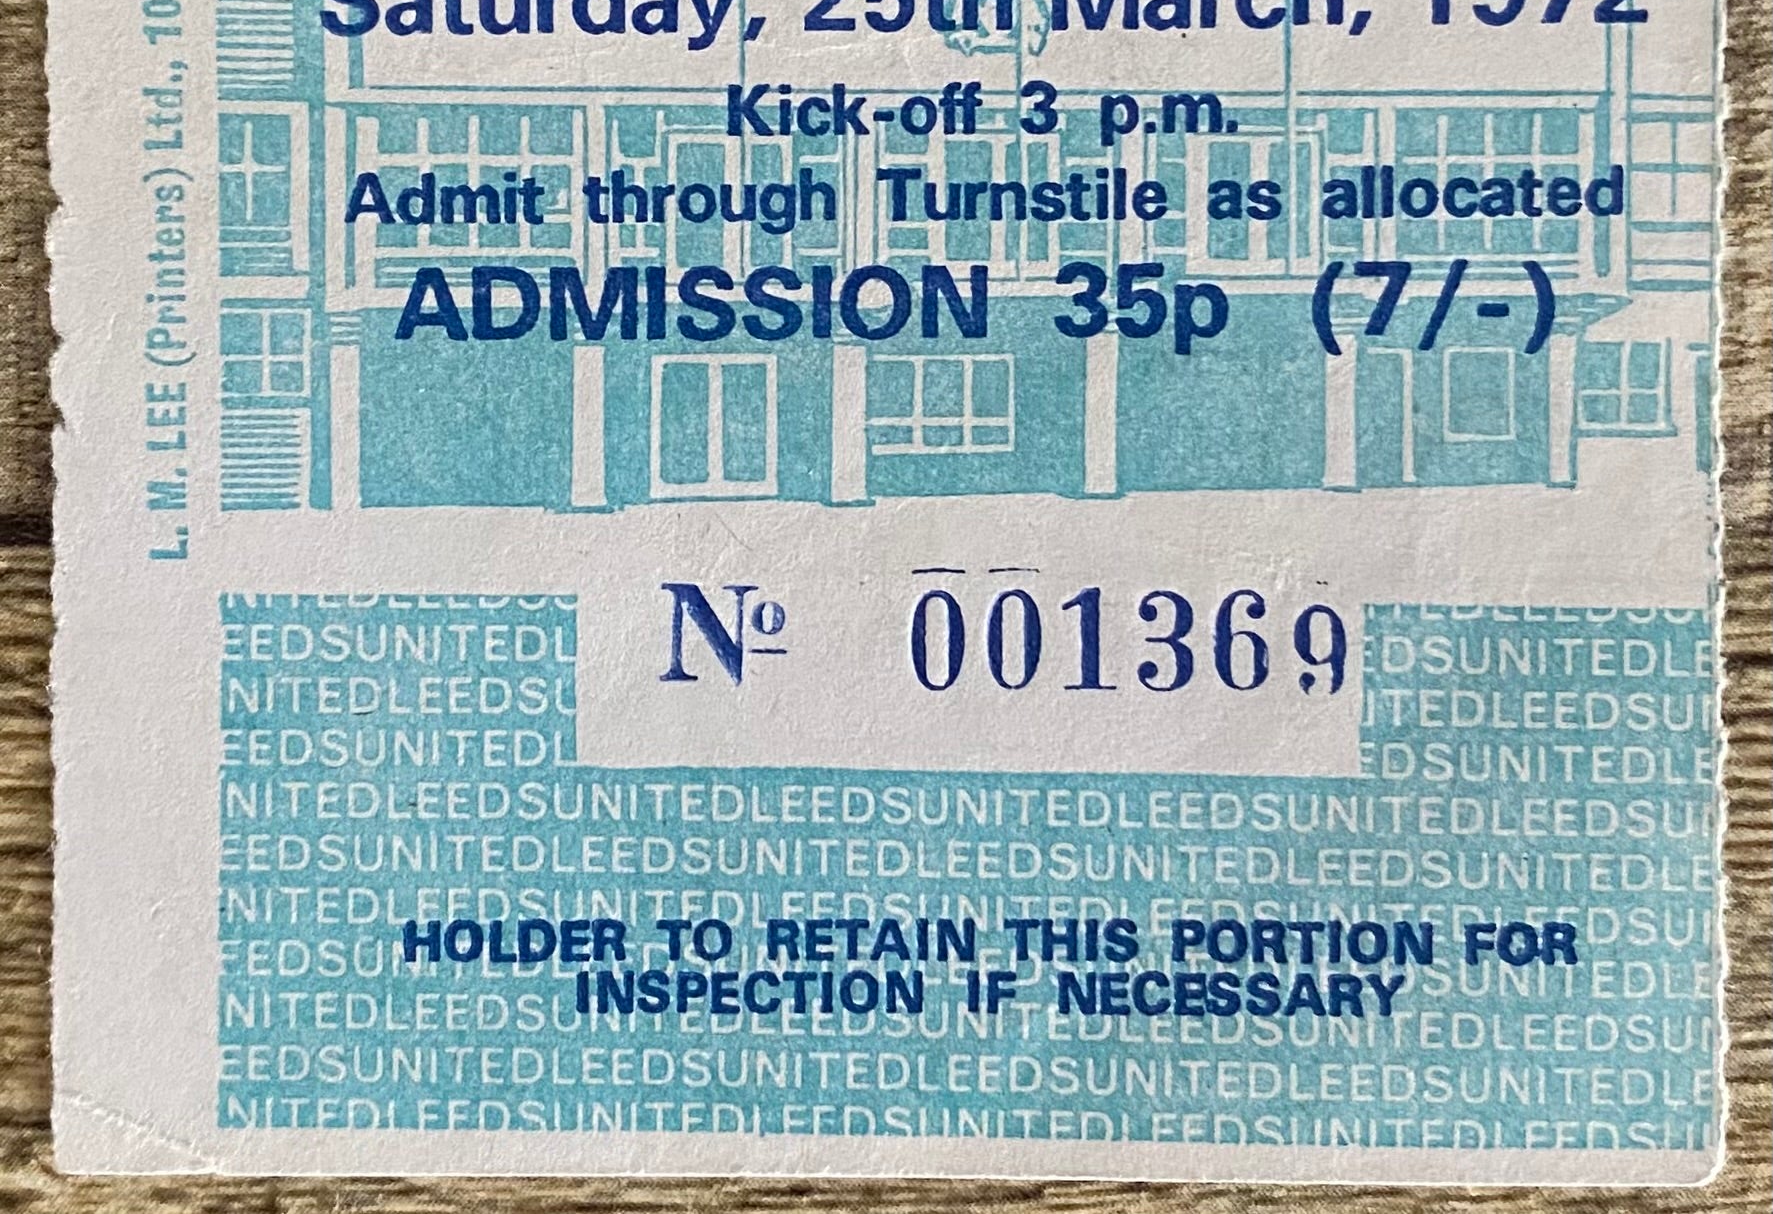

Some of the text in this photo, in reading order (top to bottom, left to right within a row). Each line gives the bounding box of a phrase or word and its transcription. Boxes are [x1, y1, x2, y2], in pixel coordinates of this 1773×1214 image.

[143, 60, 188, 151] Ltd.,
[726, 80, 1239, 146] Kick-off 3 p.m.
[345, 165, 1625, 235] Admit through Turnstile as allocated
[143, 168, 197, 367] (Printers)
[395, 258, 1556, 356] ADMISSION 35p (7/-)
[145, 383, 187, 452] LEE
[146, 468, 188, 511] M.
[147, 526, 189, 561] L.
[911, 587, 1346, 695] 001369
[402, 918, 1578, 967] HOLDER TO RETAIN THIS PORTION FOR
[576, 969, 1406, 1018] INSPECTION IF NECESSARY
